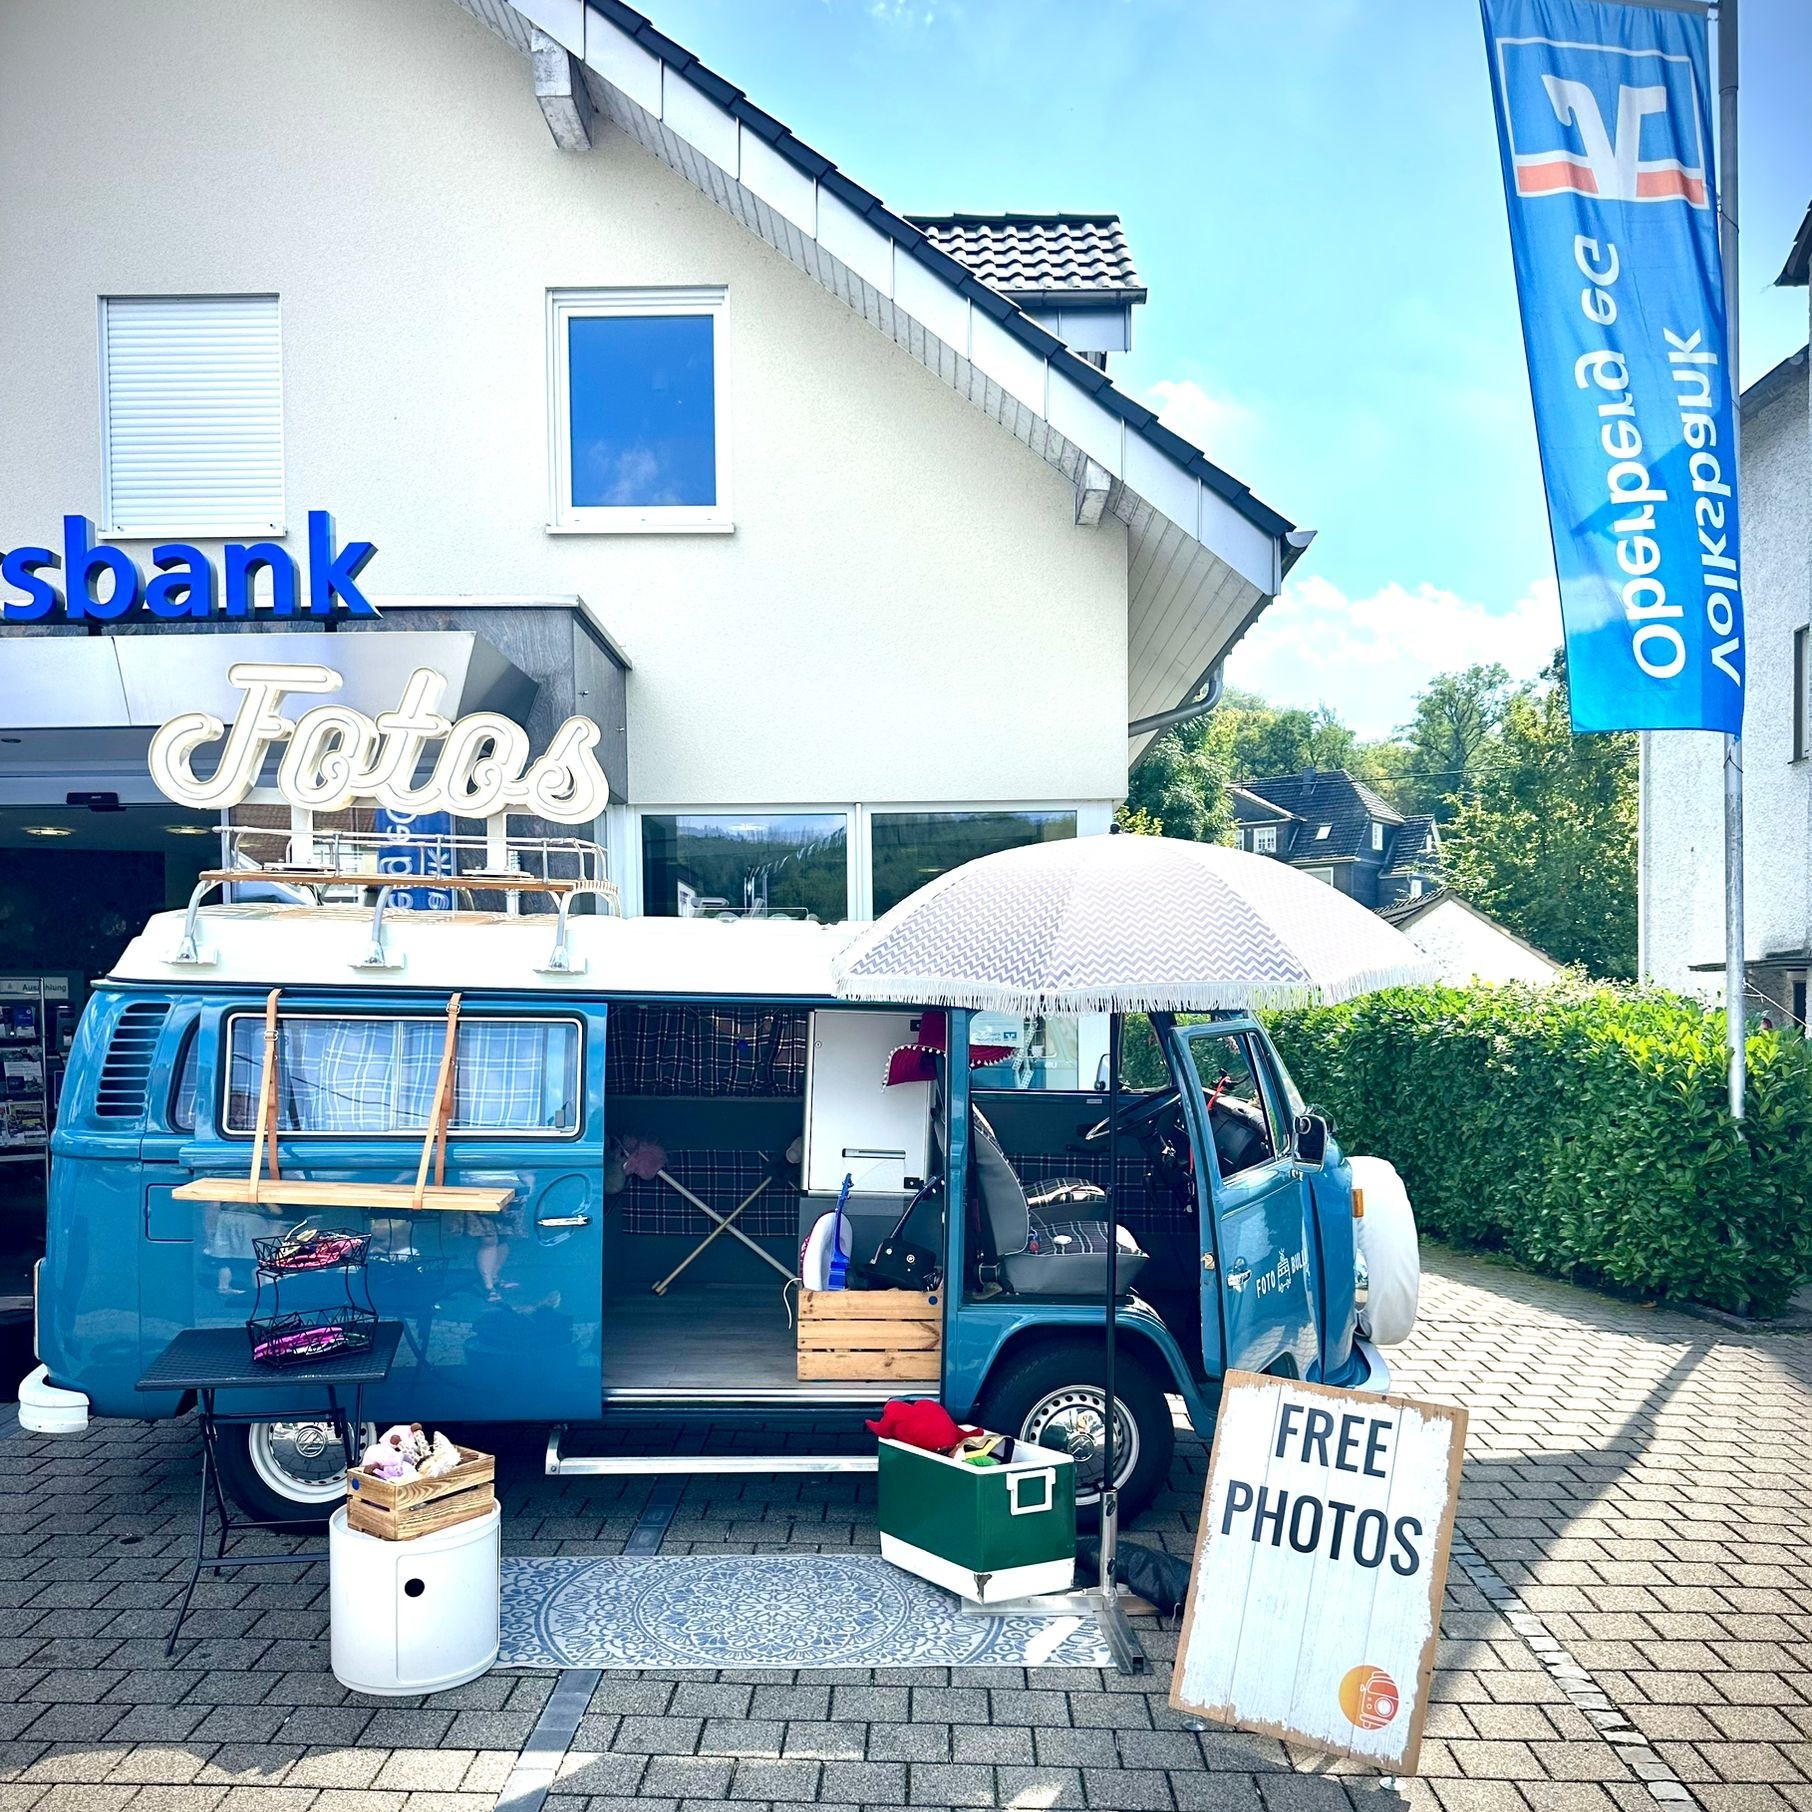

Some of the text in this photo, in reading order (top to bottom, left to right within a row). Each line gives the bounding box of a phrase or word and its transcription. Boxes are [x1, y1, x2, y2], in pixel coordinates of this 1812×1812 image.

[0, 510, 383, 620] sbank
[148, 662, 609, 824] Fotos
[22, 983, 67, 993] Aushlung
[1256, 1270, 1276, 1299] FOTO
[1276, 1403, 1393, 1478] FREE
[1221, 1480, 1423, 1576] PHOTOS
